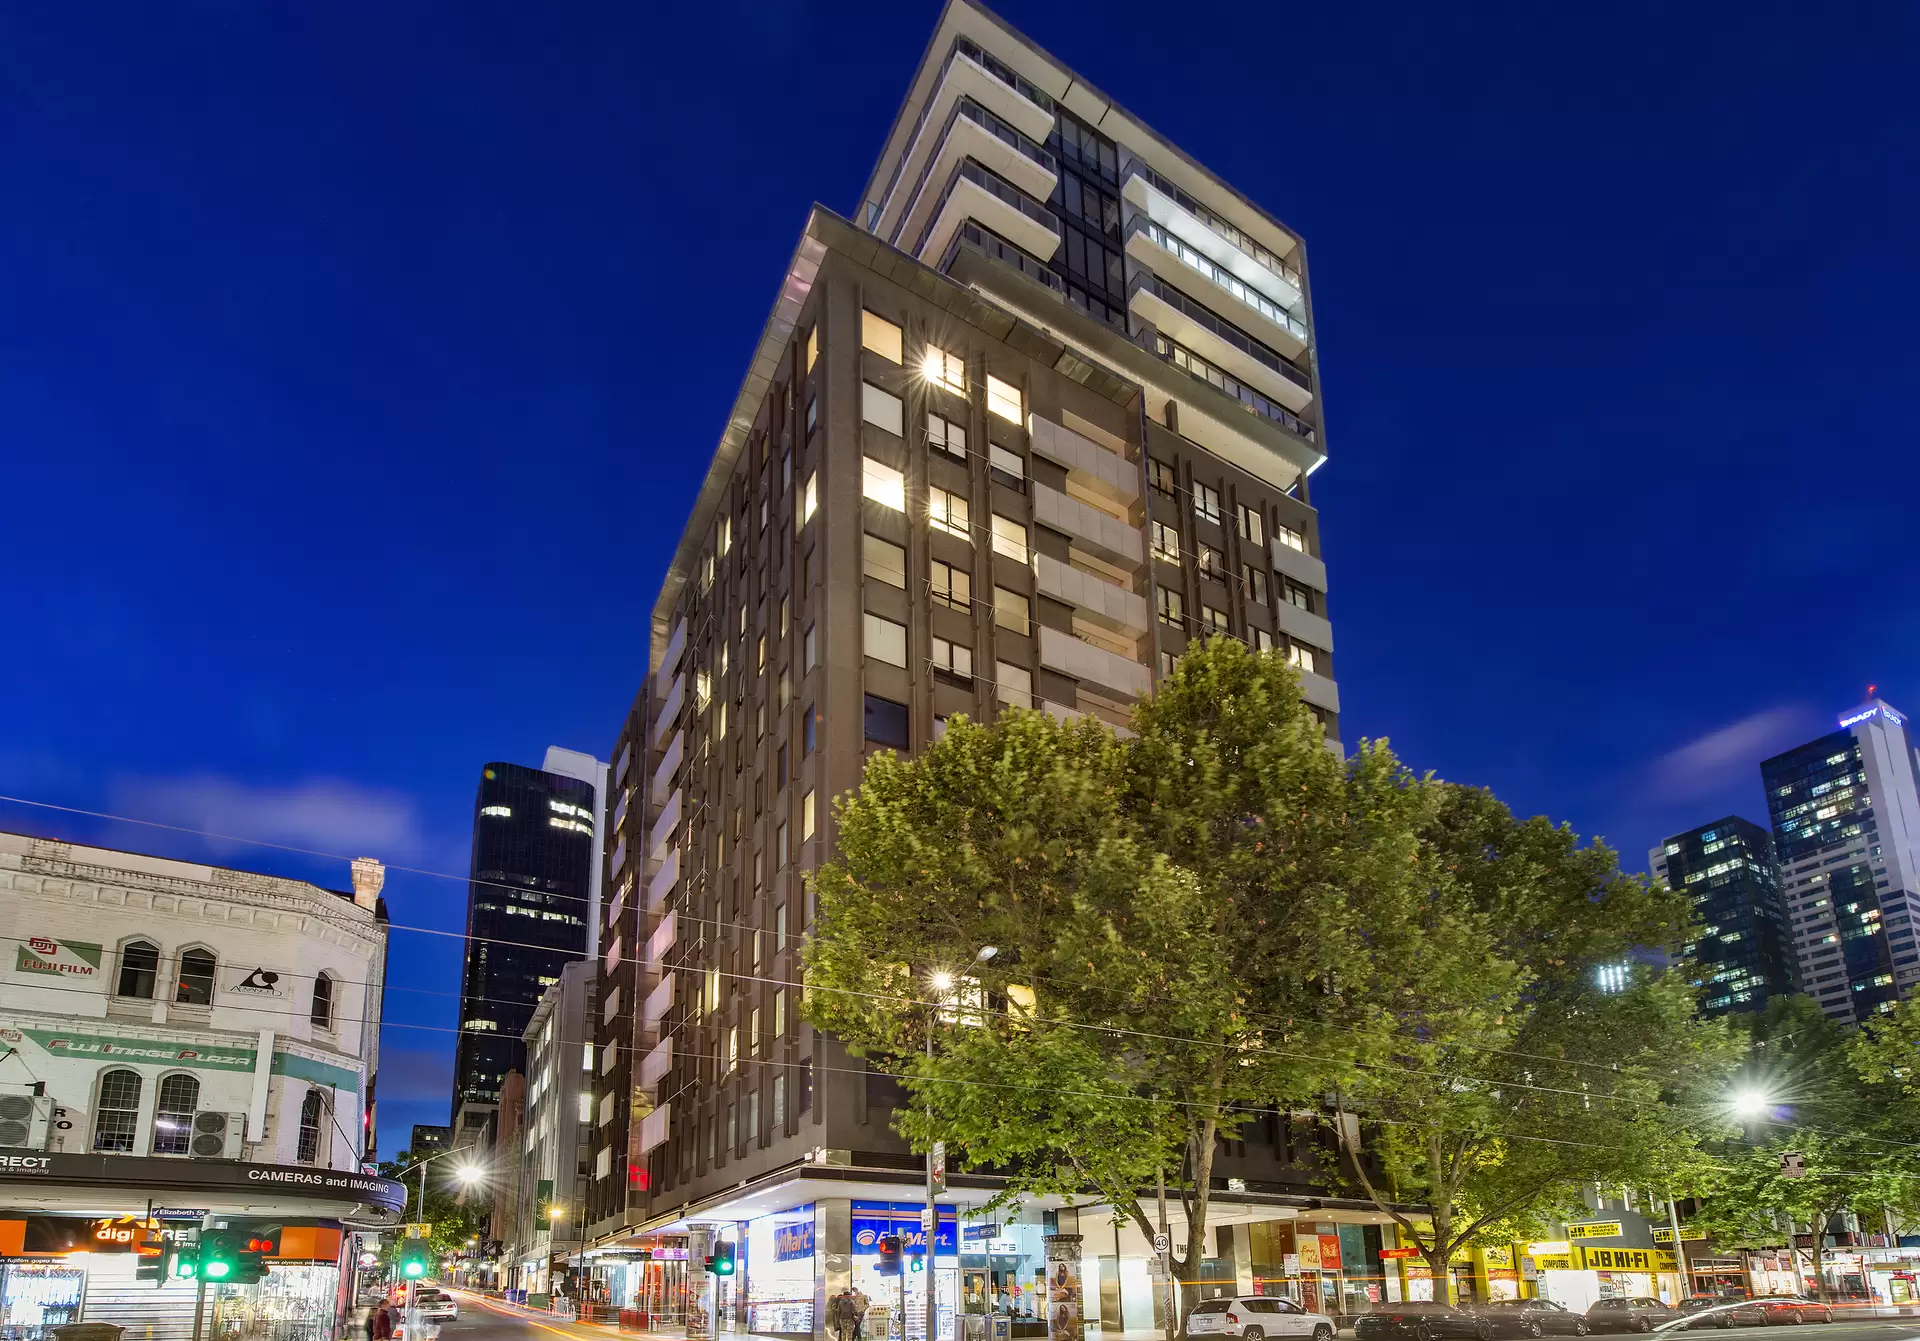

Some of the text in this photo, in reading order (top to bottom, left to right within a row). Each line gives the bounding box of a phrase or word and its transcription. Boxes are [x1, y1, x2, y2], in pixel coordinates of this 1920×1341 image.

[1840, 707, 1878, 728] BRADY
[101, 1043, 176, 1059] IMAGE
[176, 1049, 251, 1066] PLAZA
[248, 1169, 389, 1194] CAMERAS and IMAGING
[159, 1209, 195, 1217] Elizabeth
[1156, 1239, 1167, 1247] 40
[1543, 1259, 1569, 1268] COMPUTERS
[1588, 1251, 1612, 1267] JB
